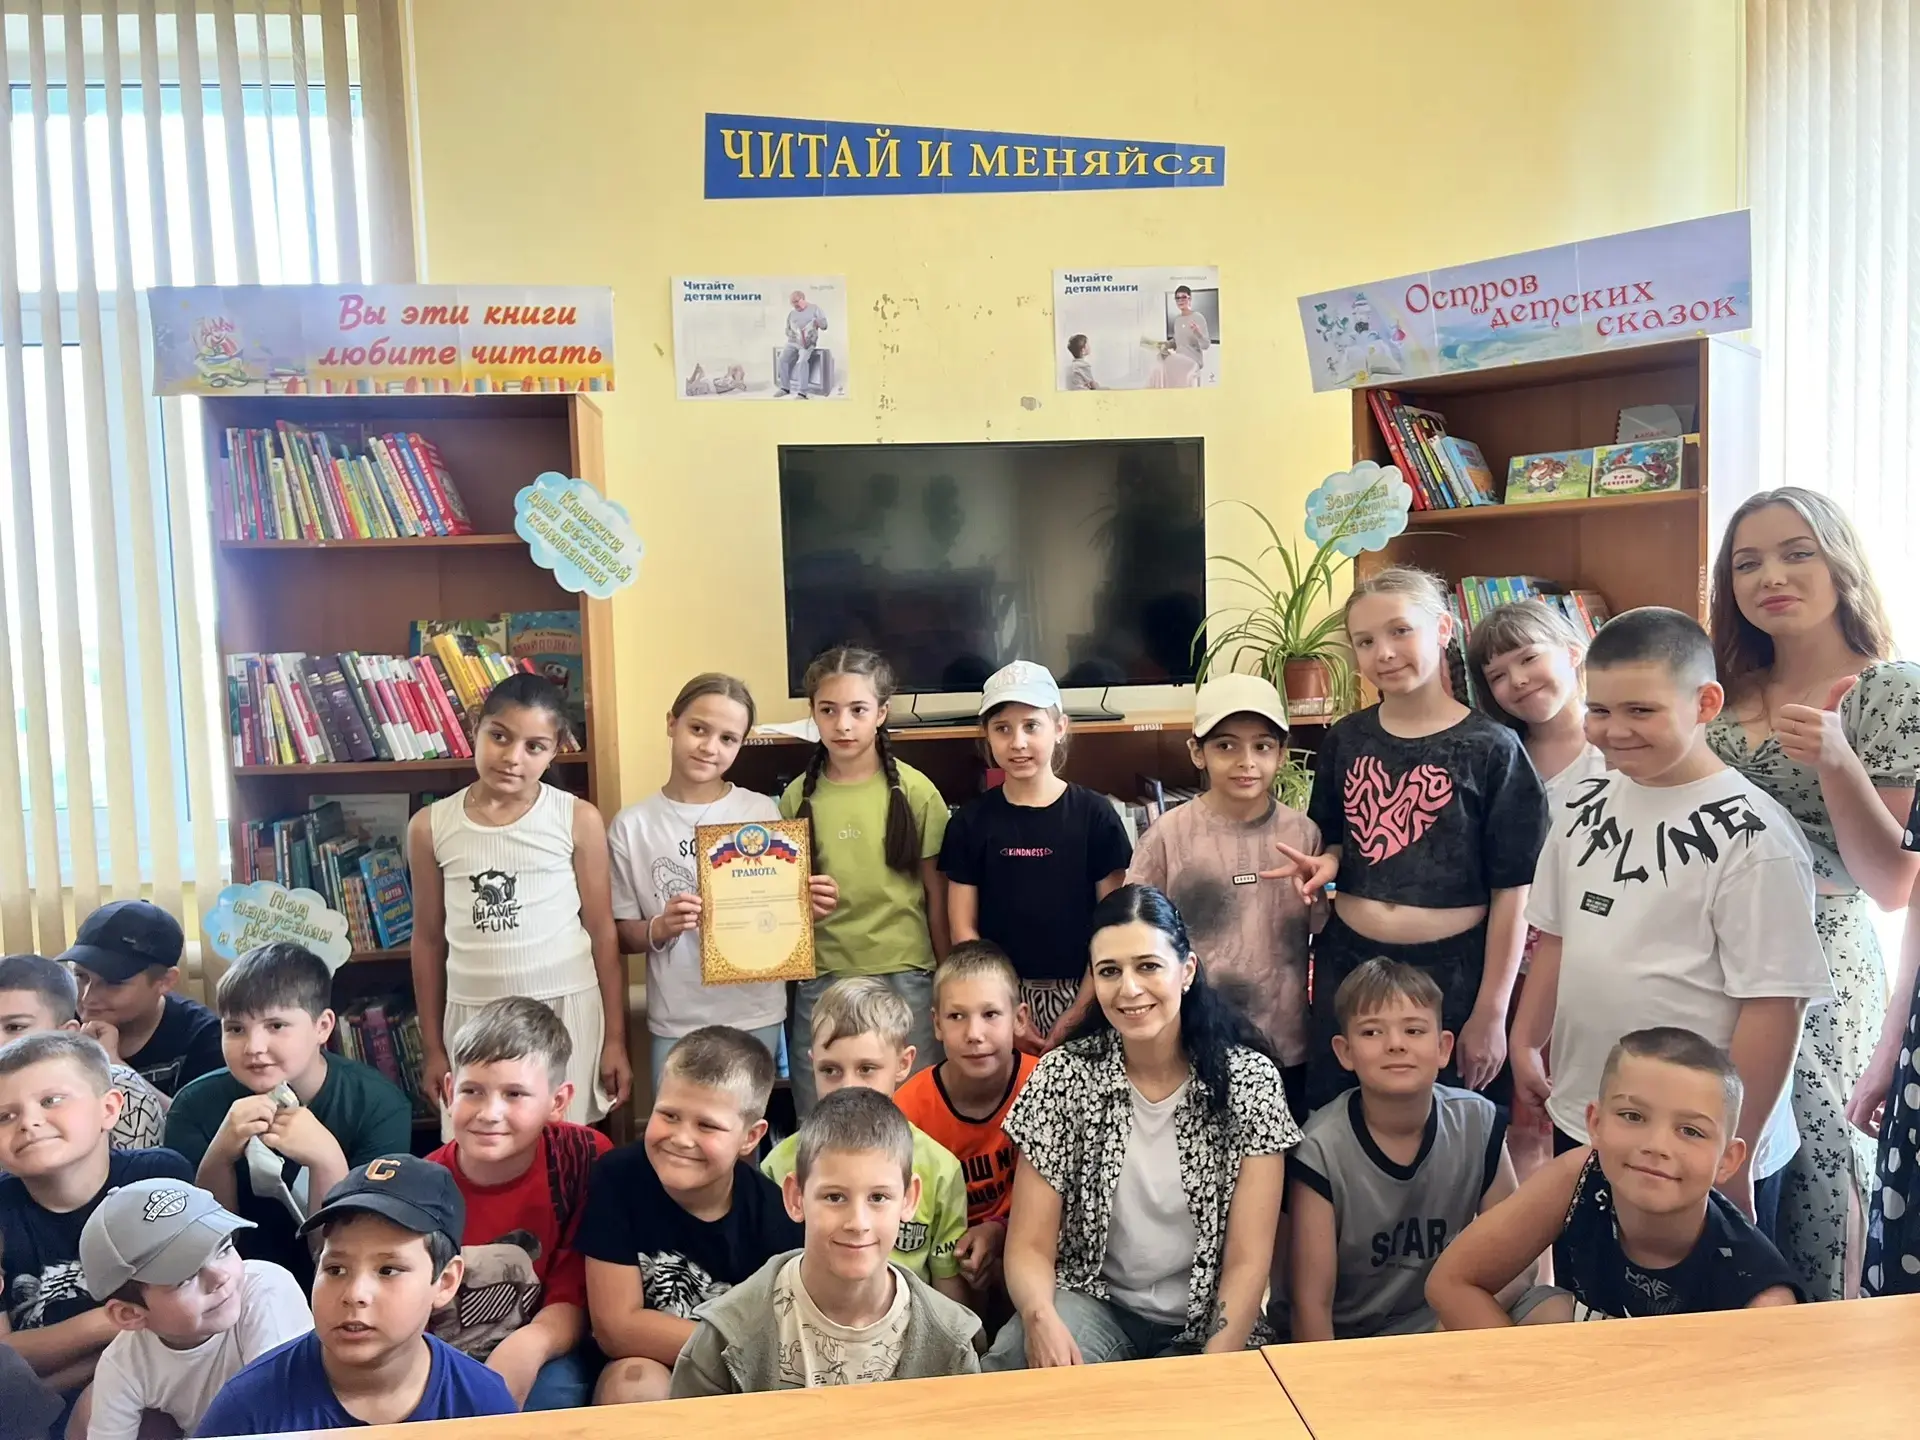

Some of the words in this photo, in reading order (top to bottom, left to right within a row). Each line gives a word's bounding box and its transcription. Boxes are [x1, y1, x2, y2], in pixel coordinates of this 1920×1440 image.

[720, 128, 900, 179] ЧИТАЙ
[917, 140, 953, 178] И
[969, 143, 1216, 178] МЕНЯЙСЯ
[683, 280, 735, 291] Читайте
[1064, 273, 1113, 283] Читайте
[1065, 285, 1101, 294] детям
[1104, 284, 1139, 293] книги
[1405, 274, 1539, 314] Остров
[339, 294, 386, 331] Вы
[401, 304, 470, 325] эти
[484, 304, 577, 326] книги
[683, 292, 722, 302] детям
[725, 292, 762, 301] книги
[1490, 280, 1655, 331] детских
[1596, 296, 1738, 337] сказок
[318, 336, 457, 366] любите
[471, 343, 603, 365] читать
[527, 491, 562, 521] для
[560, 518, 632, 582] веселой
[559, 490, 625, 553] Книжки
[527, 512, 609, 587] компании
[731, 866, 778, 879] ГРАМОТА
[233, 900, 333, 944] парусами
[269, 890, 310, 921] Под
[365, 1158, 402, 1181] C
